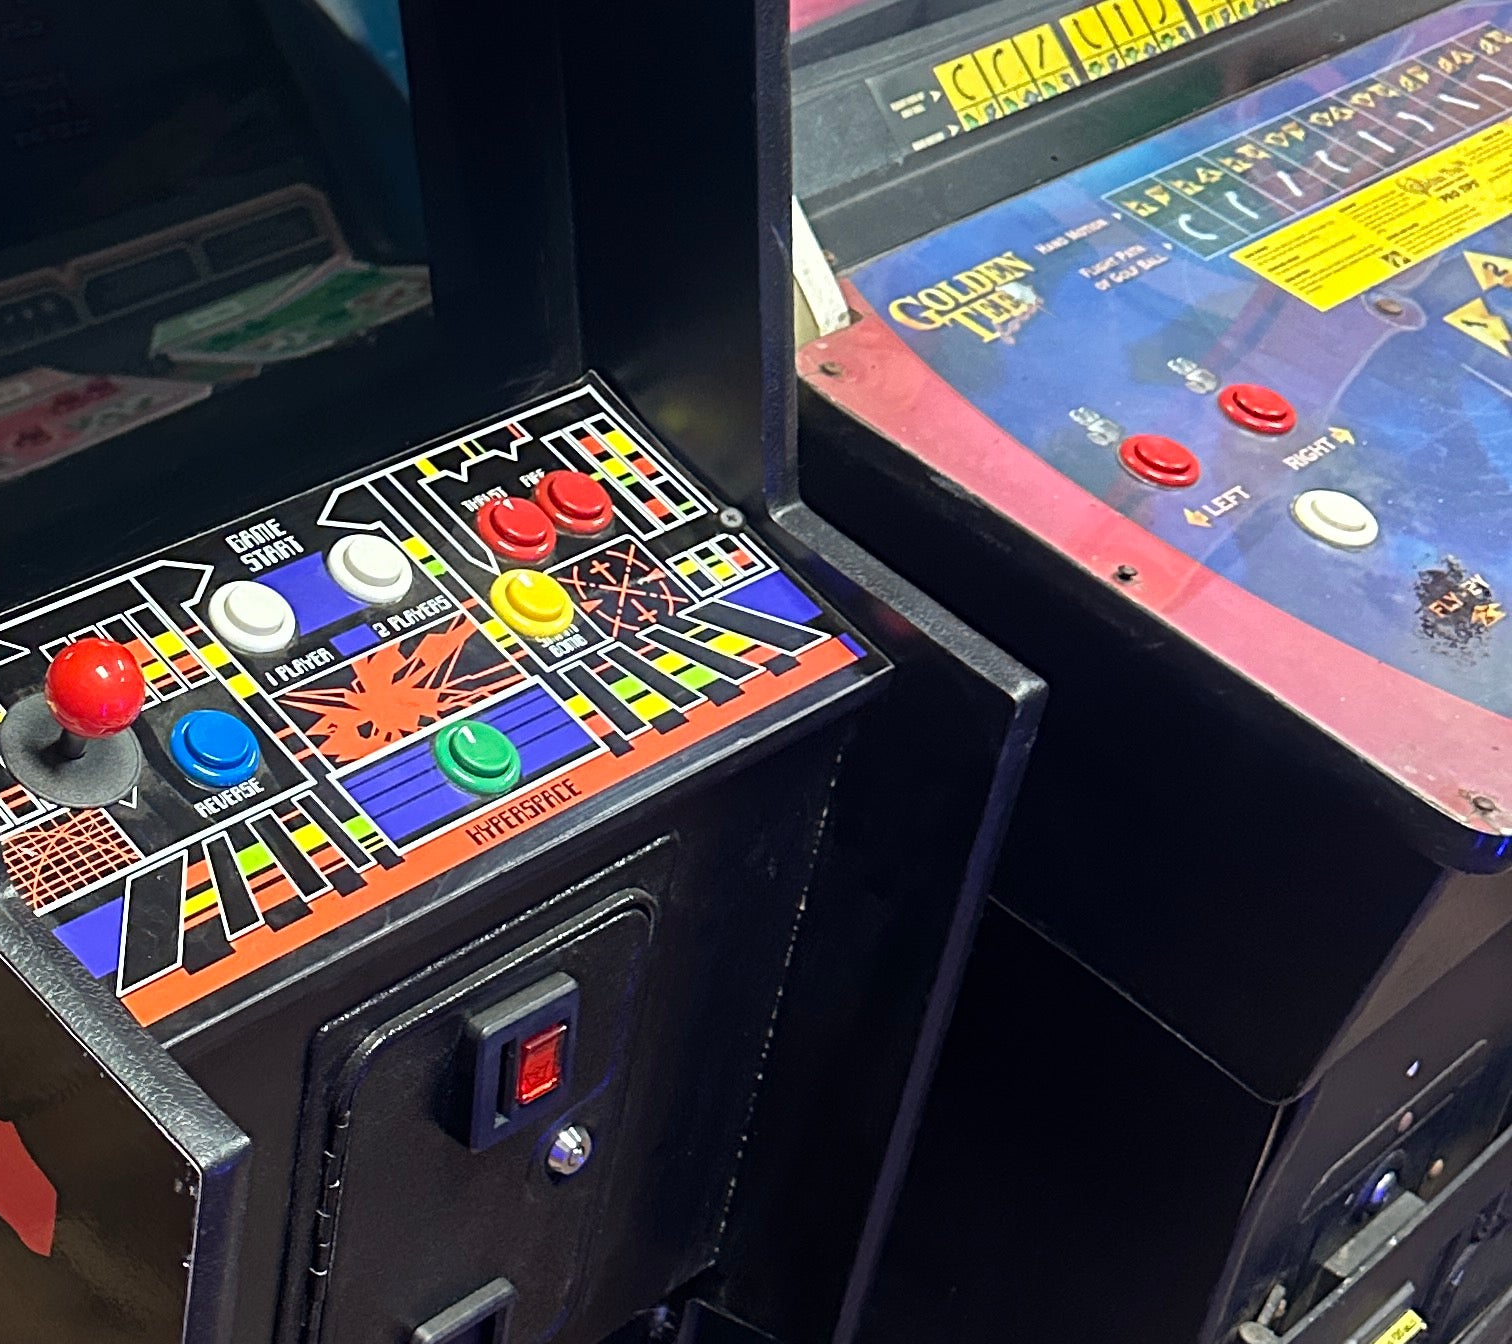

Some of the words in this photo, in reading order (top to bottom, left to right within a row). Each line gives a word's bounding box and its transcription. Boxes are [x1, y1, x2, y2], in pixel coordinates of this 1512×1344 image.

[889, 251, 1035, 331] GOLDEN
[940, 289, 1034, 343] TEE
[1282, 436, 1337, 471] RIGHT
[1202, 485, 1251, 517] LEFT
[225, 518, 287, 555] GAME
[240, 535, 304, 574] START
[372, 621, 391, 639] 2
[390, 595, 453, 632] PLAYERS
[266, 670, 279, 687] 1
[275, 647, 335, 680] PLAYER
[194, 778, 265, 819] REVERSE
[466, 778, 583, 846] HYPERSPACE
